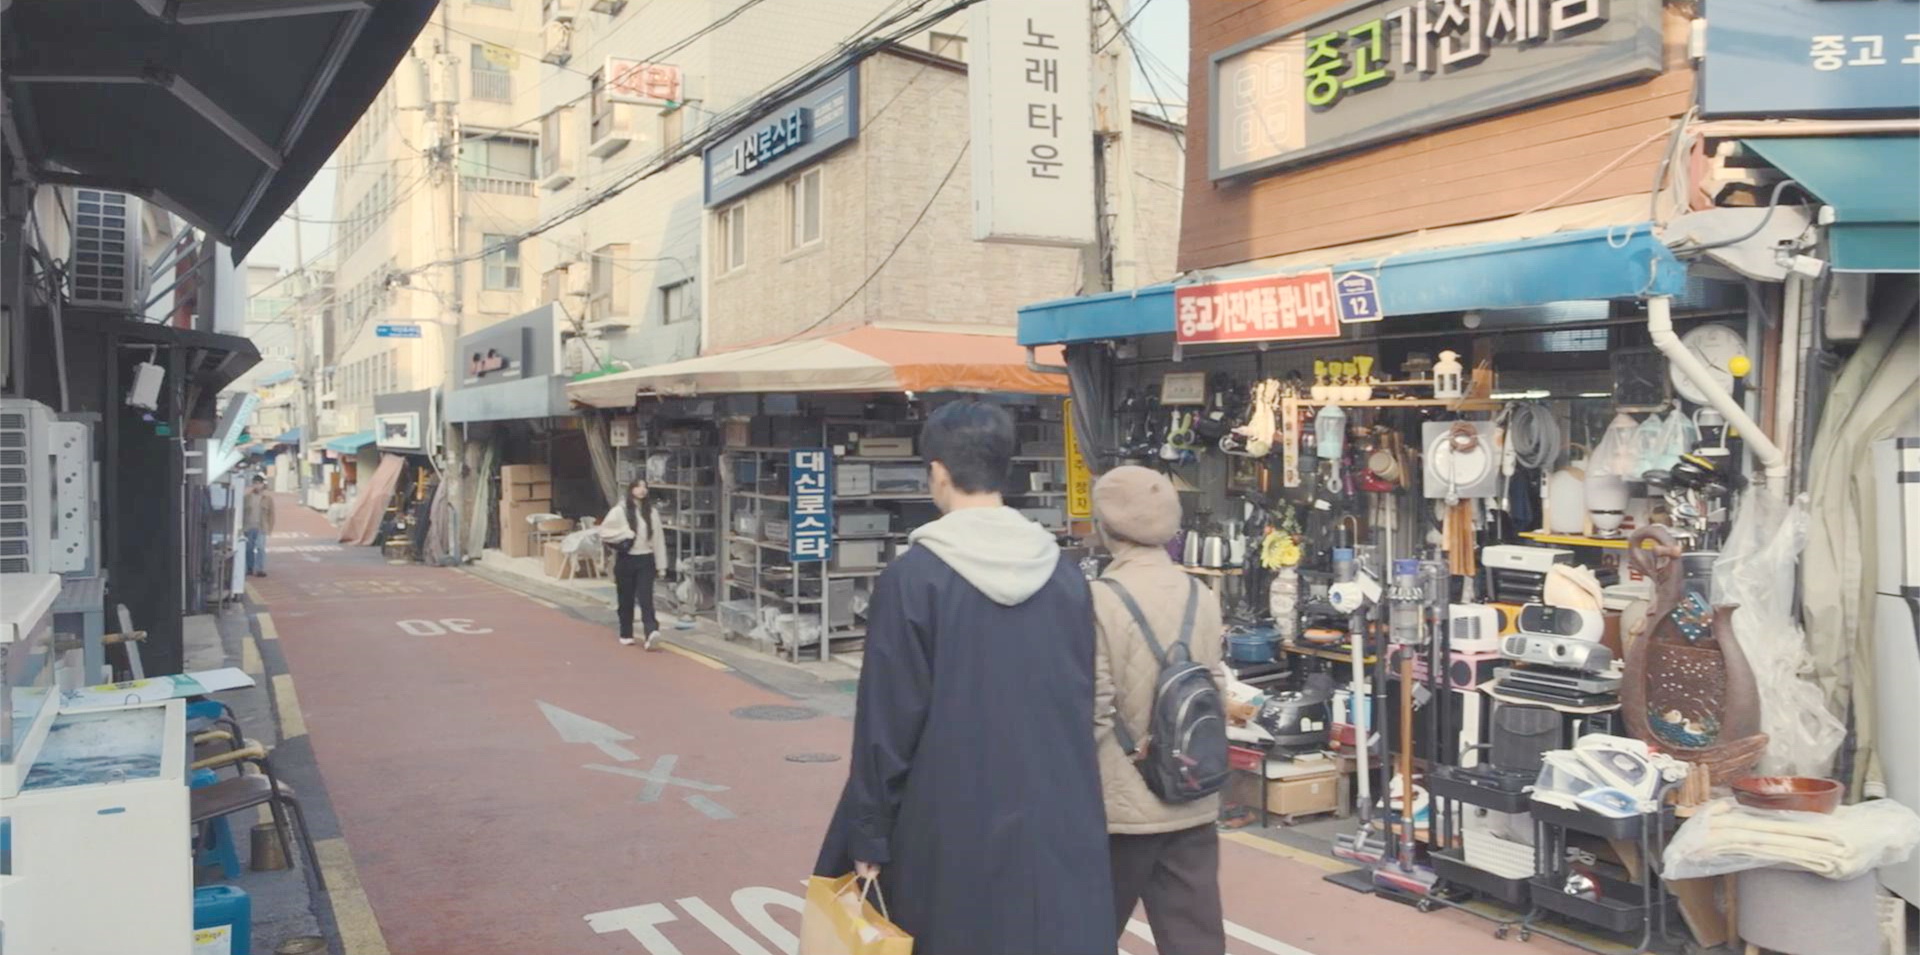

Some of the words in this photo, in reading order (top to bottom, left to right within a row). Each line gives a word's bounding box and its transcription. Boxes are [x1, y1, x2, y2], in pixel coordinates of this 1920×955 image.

[1809, 34, 1887, 71] 중고
[1022, 18, 1063, 179] 노래타운
[1180, 281, 1332, 337] 중고가전제품팝니다
[1349, 296, 1369, 315] 12
[795, 451, 829, 558] 대신로스타
[396, 618, 493, 636] 30
